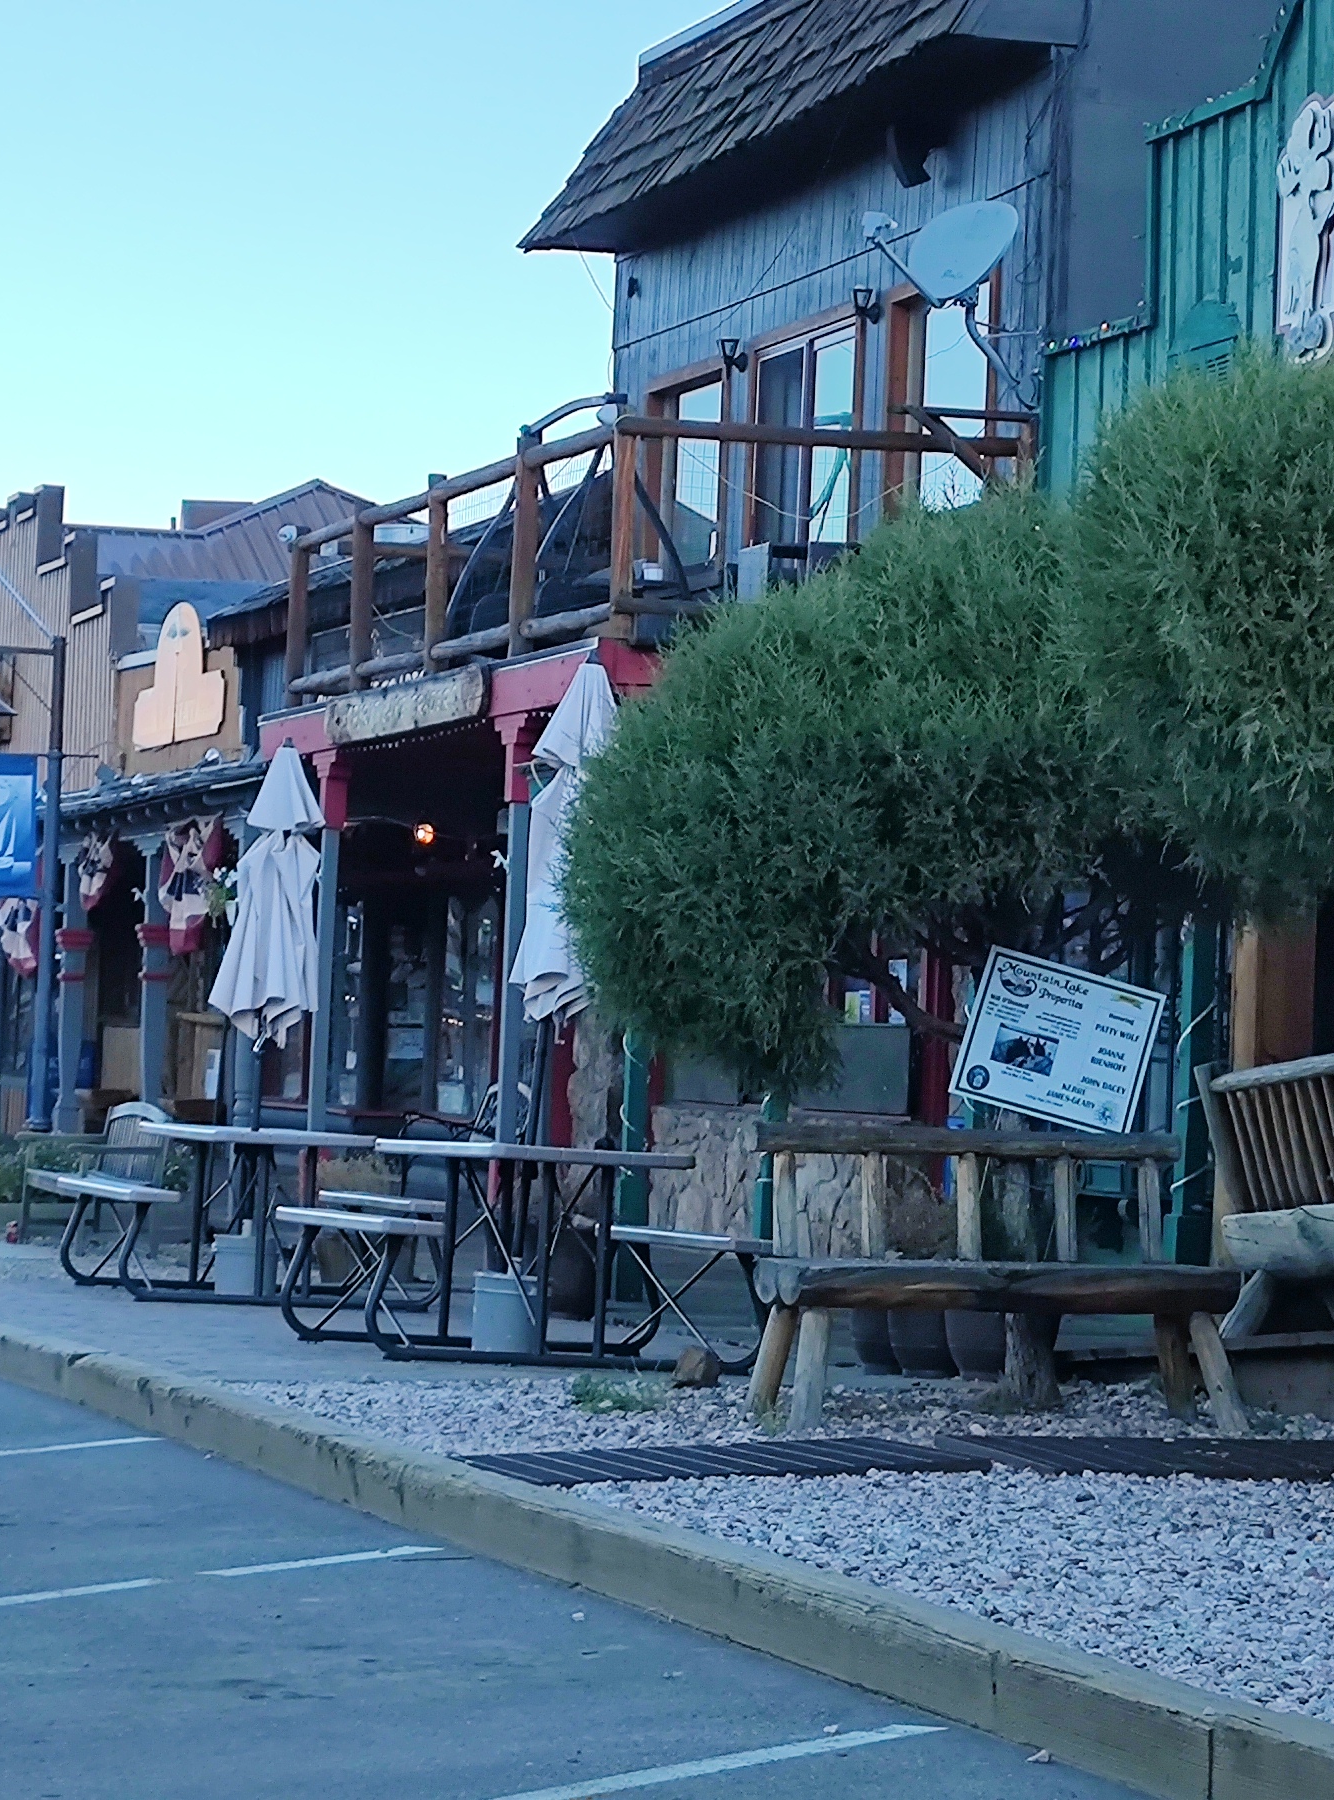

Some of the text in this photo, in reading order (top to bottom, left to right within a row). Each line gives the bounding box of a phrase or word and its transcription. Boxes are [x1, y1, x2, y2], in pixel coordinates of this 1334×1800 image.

[997, 961, 1089, 996] Mountain Lake
[1039, 988, 1083, 1009] Properties
[1095, 1023, 1140, 1042] PATTY WOLF
[1097, 1047, 1126, 1061] JOANNE
[1080, 1075, 1100, 1088] JOHN
